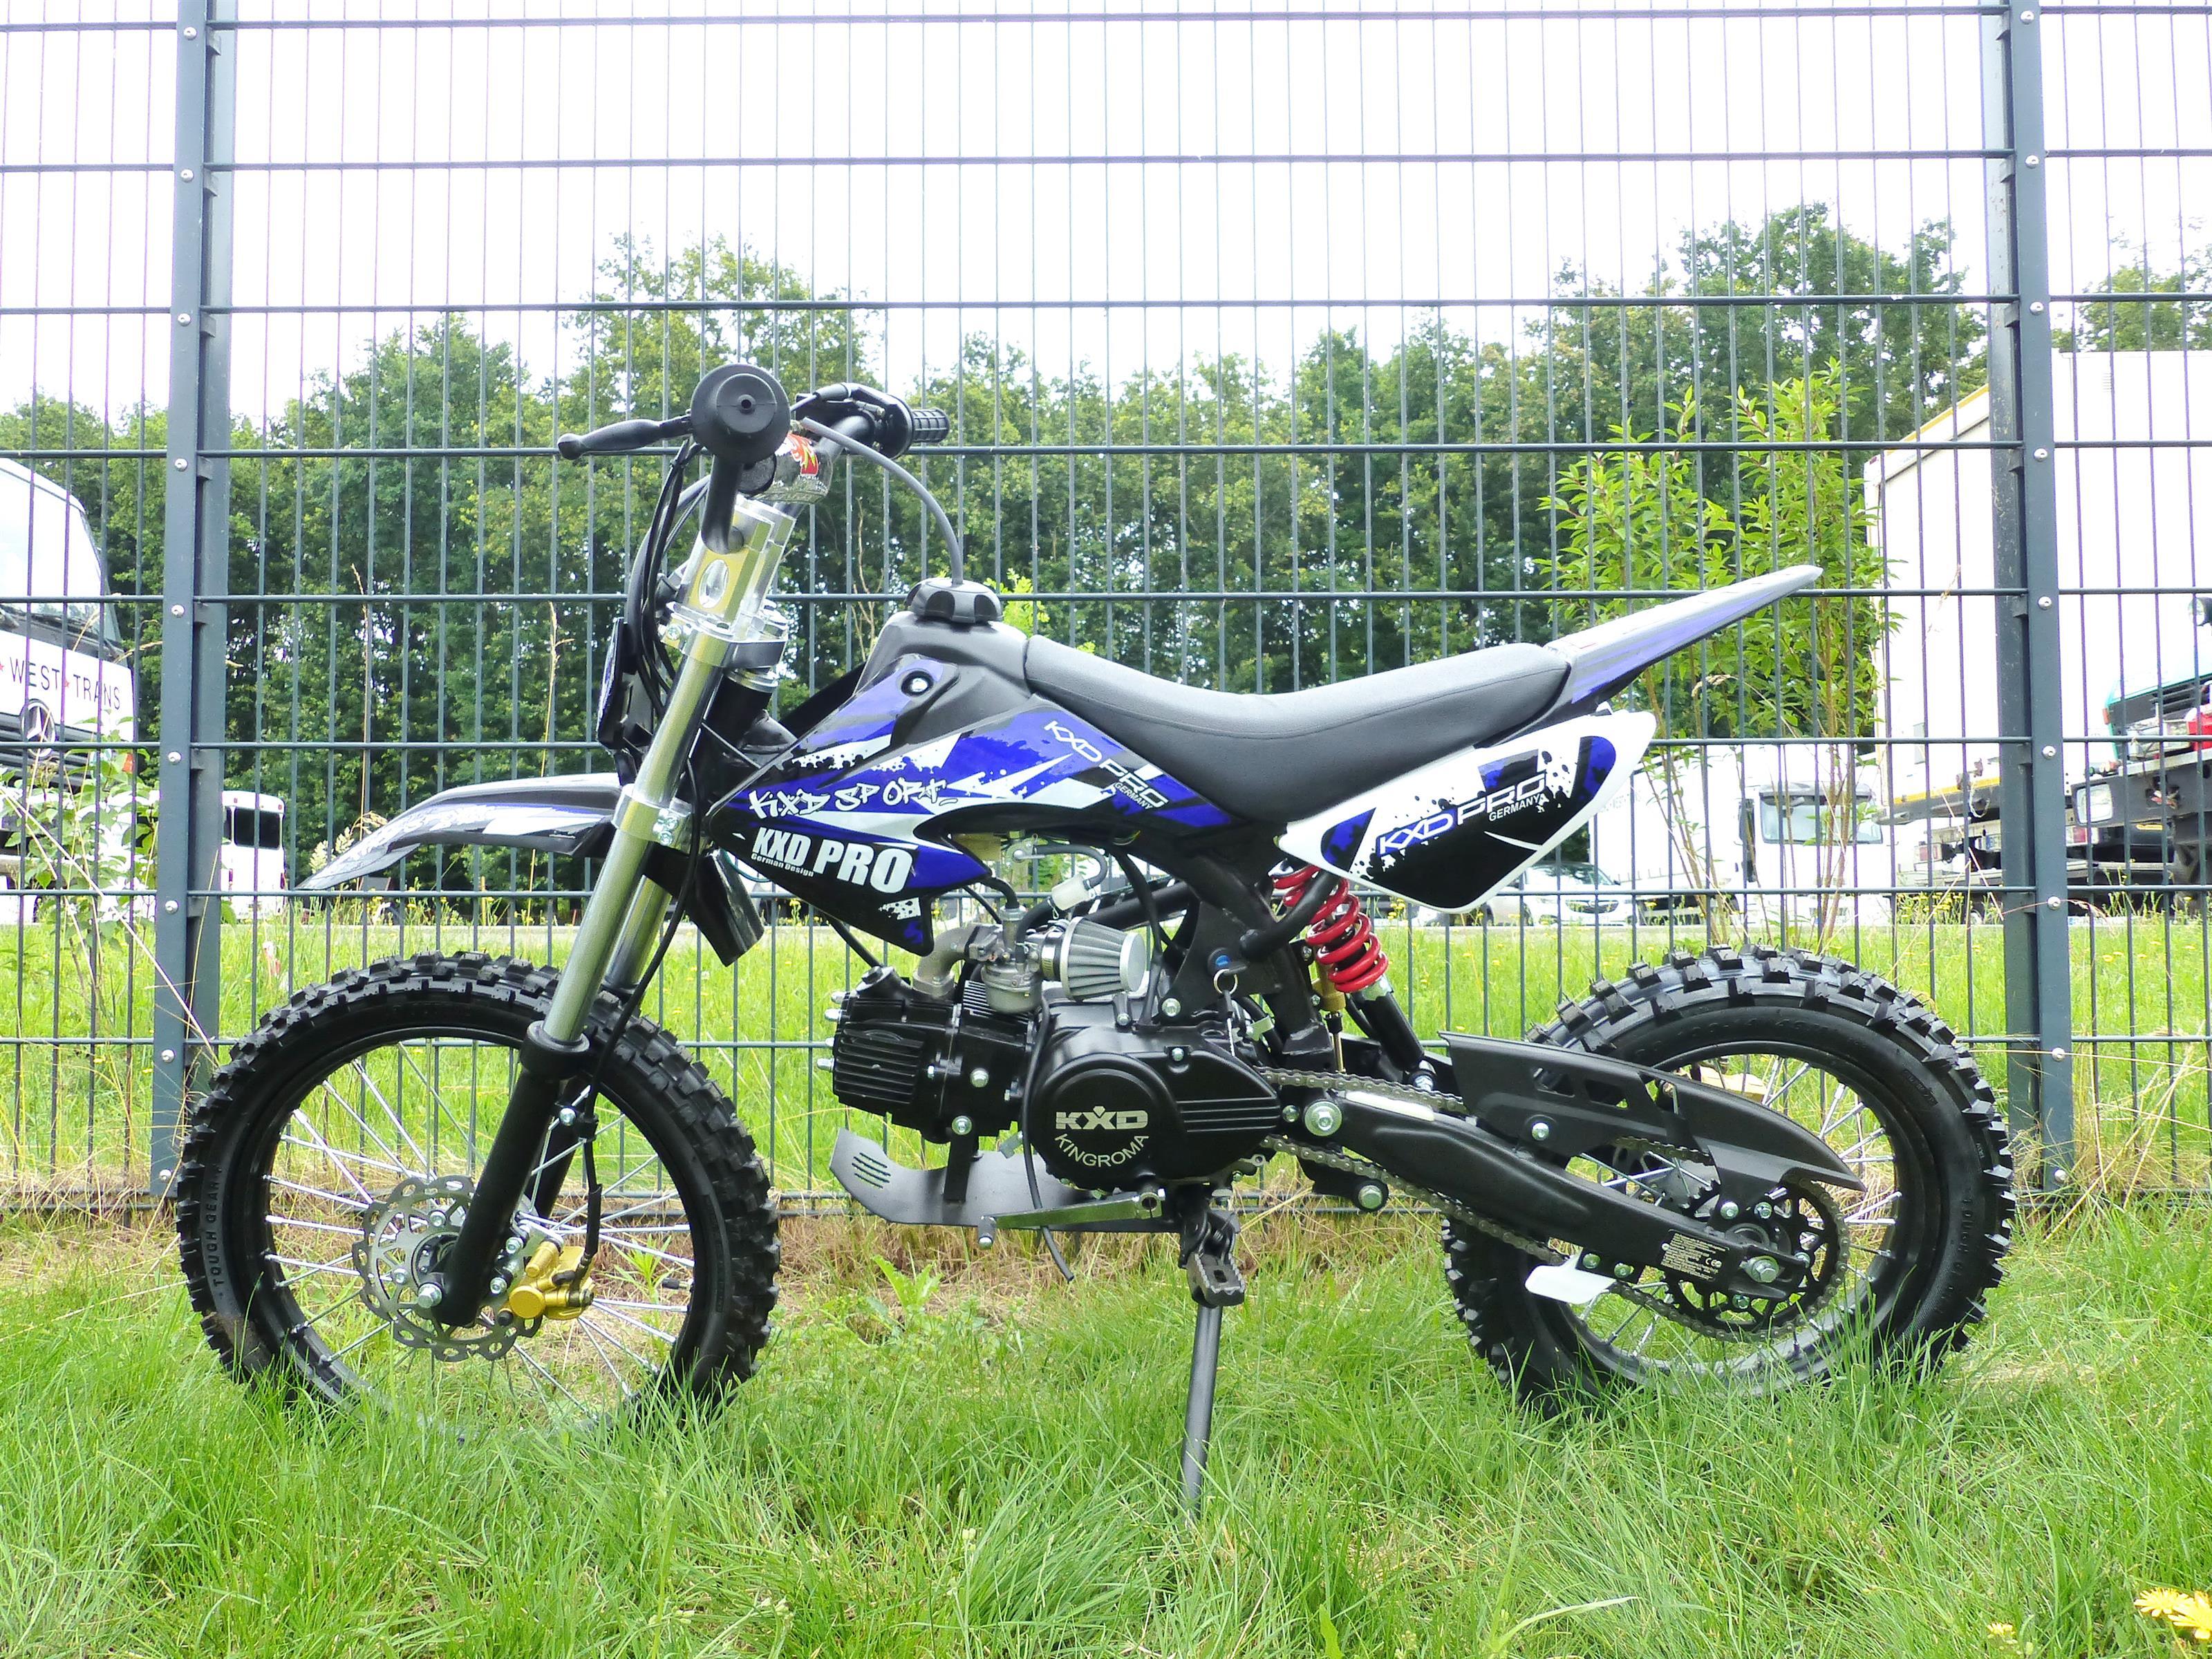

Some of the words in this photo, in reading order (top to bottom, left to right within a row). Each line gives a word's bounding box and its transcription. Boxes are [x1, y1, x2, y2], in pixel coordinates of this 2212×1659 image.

[1044, 720, 1103, 762] KXD
[1099, 758, 1169, 808] PRO
[749, 789, 830, 819] KXD
[1114, 782, 1153, 810] GERMANY
[1489, 795, 1541, 821] GERMANY
[1380, 812, 1454, 855] KXD
[1457, 773, 1545, 825] PRO
[751, 853, 784, 868] German
[785, 863, 814, 877] Design
[752, 827, 812, 867] KXD
[813, 838, 913, 894] PRO
[1056, 1105, 1149, 1130] KXD
[1054, 1133, 1150, 1168] KINGROMA
[206, 1231, 225, 1287] TOUGH
